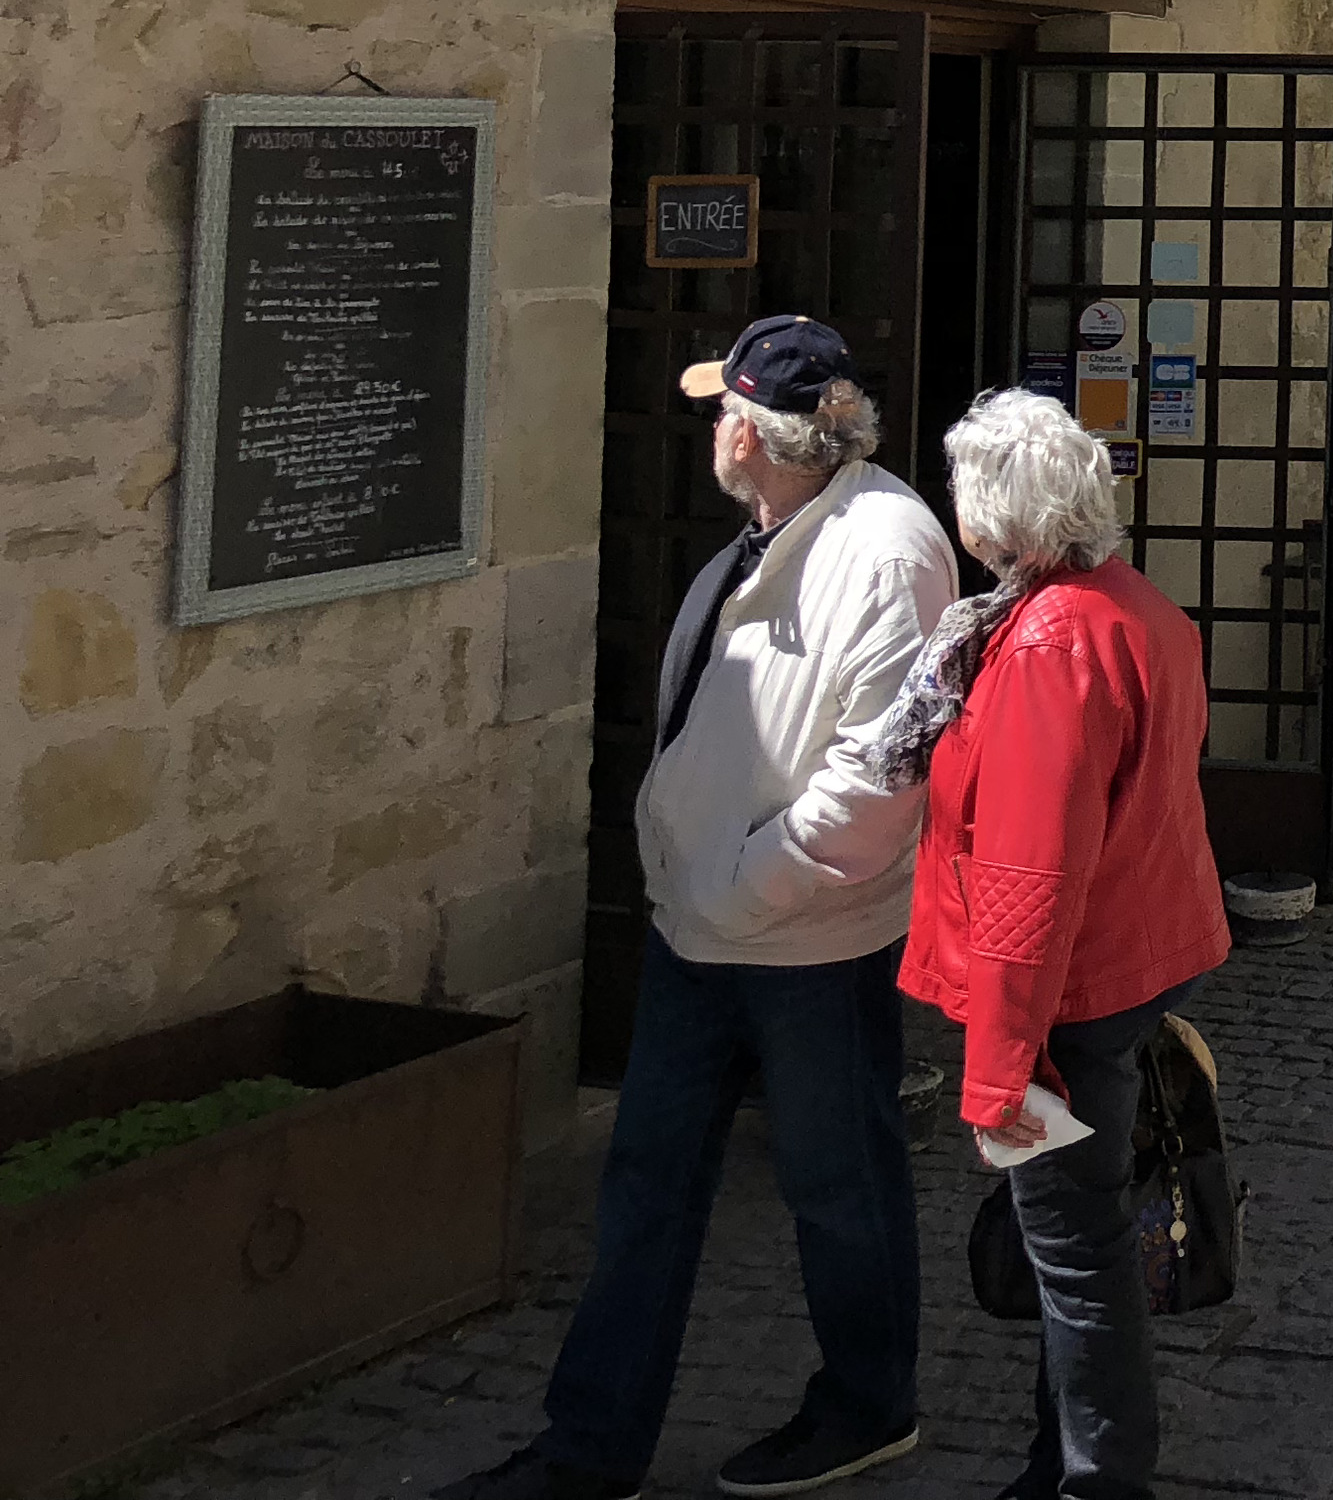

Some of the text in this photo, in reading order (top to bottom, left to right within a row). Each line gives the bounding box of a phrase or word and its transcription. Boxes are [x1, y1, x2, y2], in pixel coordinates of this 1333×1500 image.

[245, 131, 315, 150] MAISON
[343, 129, 445, 150] CASSOULET
[660, 195, 746, 232] ENTRÉE
[1089, 354, 1123, 363] Chèque
[1088, 364, 1128, 374] Déjeuner
